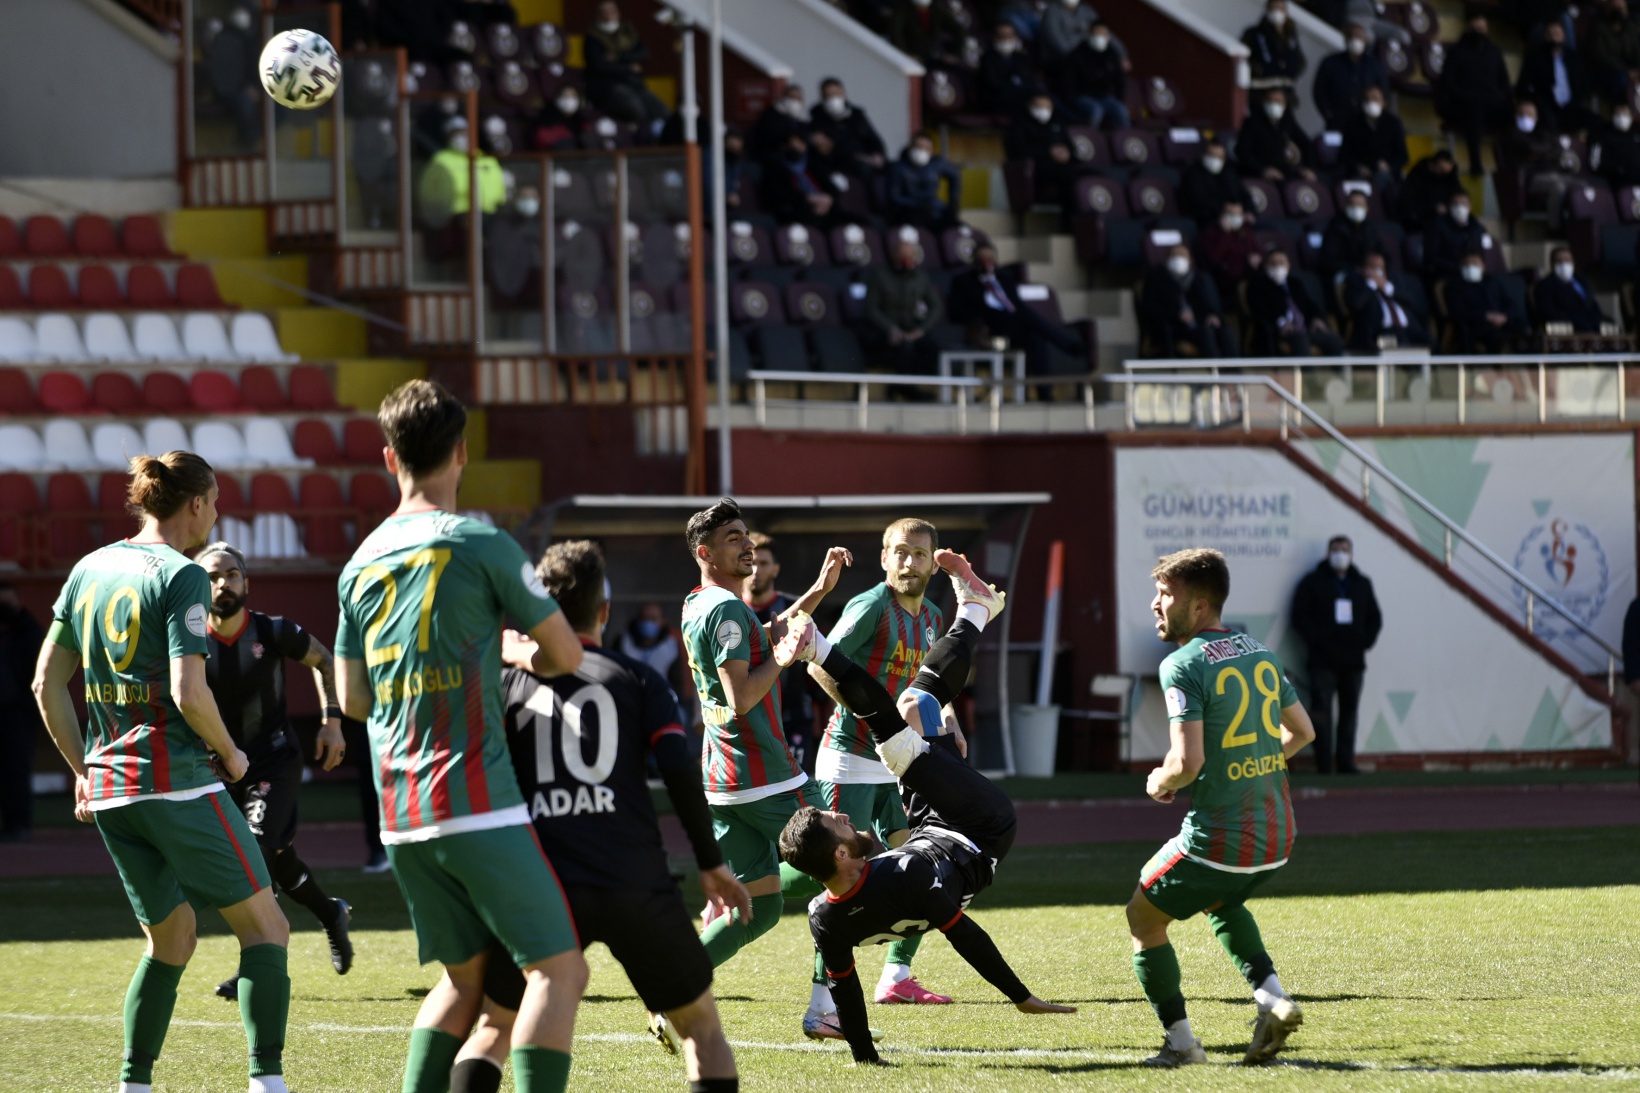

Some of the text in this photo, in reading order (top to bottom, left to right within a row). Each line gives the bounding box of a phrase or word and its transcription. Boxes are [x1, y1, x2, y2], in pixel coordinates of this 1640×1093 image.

[74, 581, 141, 673] 19
[350, 548, 452, 668] 27
[516, 683, 619, 786] 10
[1215, 660, 1281, 749] 28
[532, 785, 617, 820] ADAR
